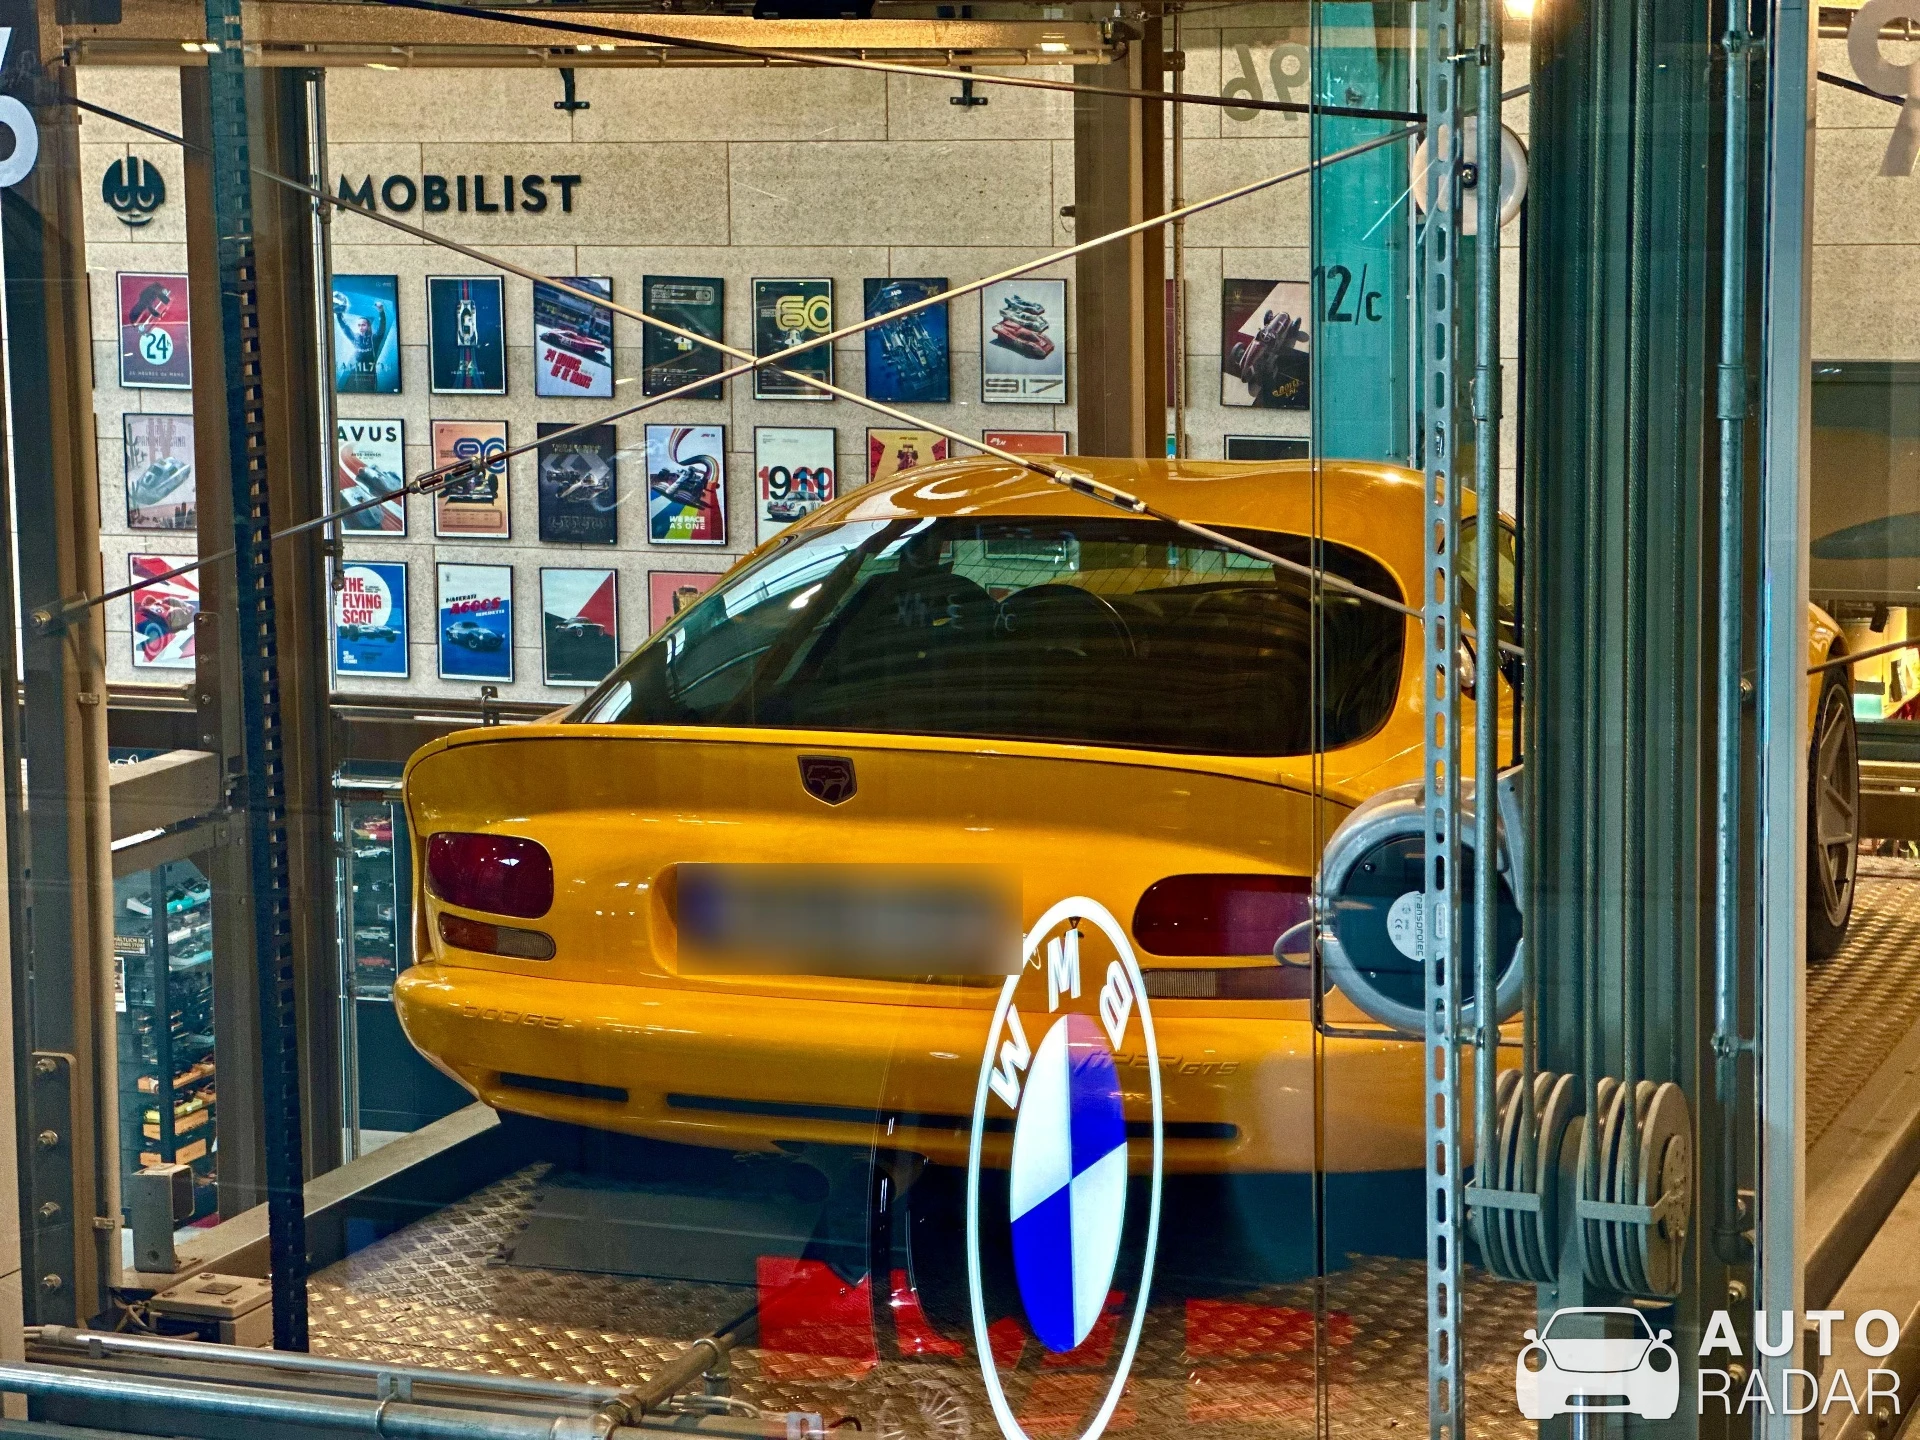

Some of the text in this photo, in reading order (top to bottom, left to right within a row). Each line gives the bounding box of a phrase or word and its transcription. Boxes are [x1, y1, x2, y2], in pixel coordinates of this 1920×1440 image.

[336, 174, 582, 214] MOBILIST
[775, 295, 830, 333] 60
[985, 379, 1063, 394] 917
[337, 426, 397, 442] AVUS
[343, 577, 364, 592] THE
[342, 593, 382, 610] FLYING
[342, 609, 373, 625] SCOT
